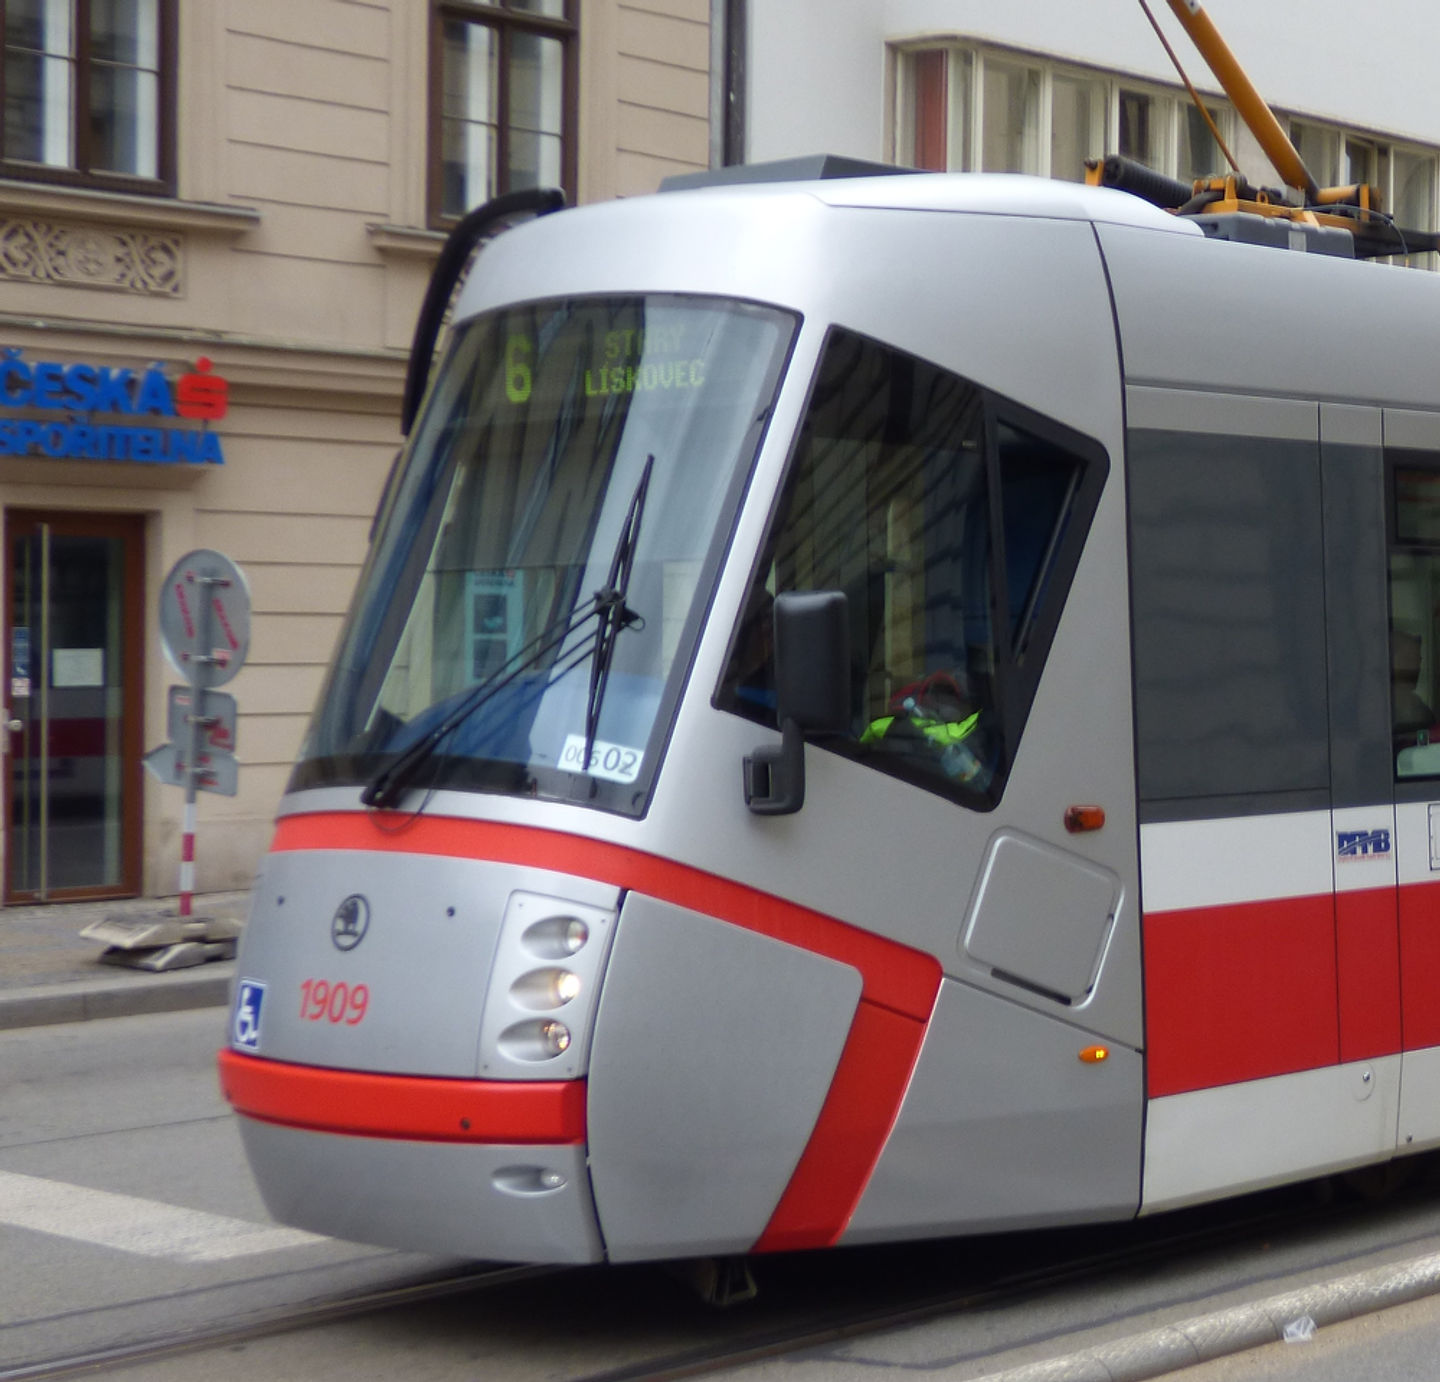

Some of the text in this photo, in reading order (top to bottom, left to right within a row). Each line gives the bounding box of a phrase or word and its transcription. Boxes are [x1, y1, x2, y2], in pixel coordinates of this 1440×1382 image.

[0, 348, 176, 417] ČESKÁ
[505, 333, 533, 404] 6
[0, 416, 225, 464] SPOŘITELNA
[299, 978, 370, 1026] 1909
